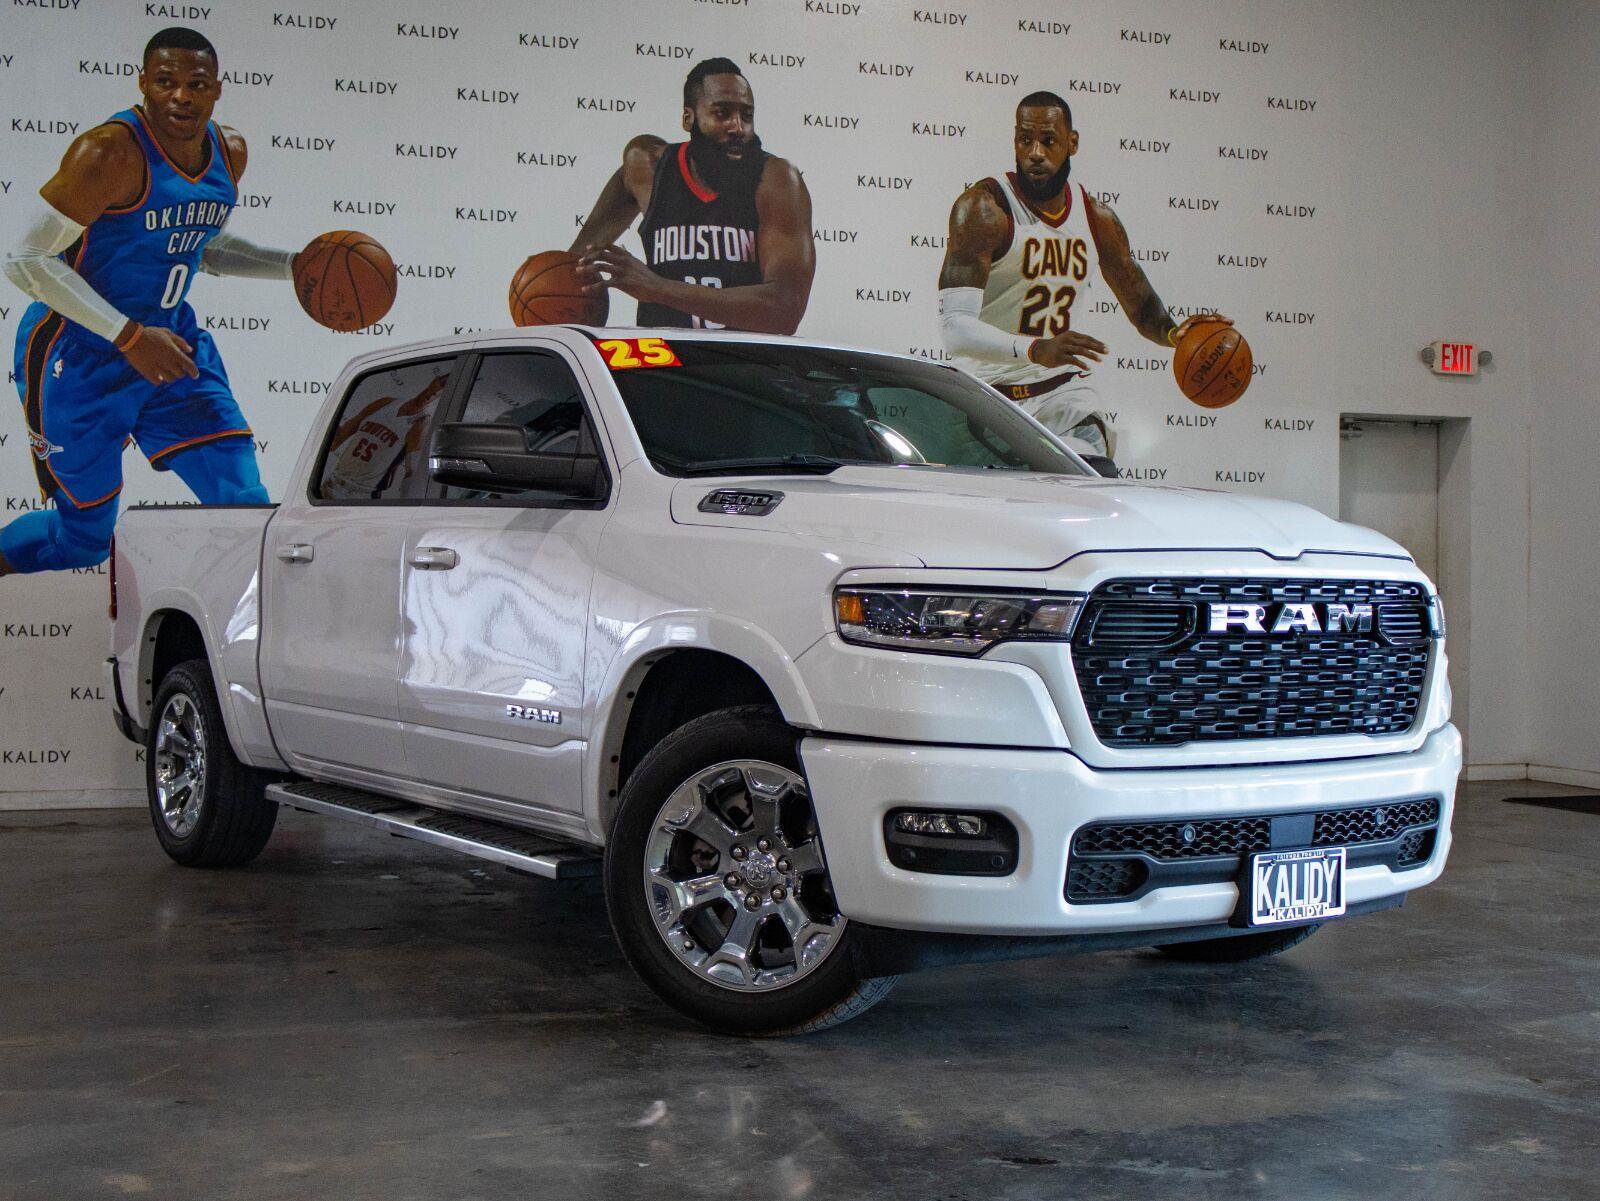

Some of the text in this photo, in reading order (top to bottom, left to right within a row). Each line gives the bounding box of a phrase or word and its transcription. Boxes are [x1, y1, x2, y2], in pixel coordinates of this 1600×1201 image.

[146, 3, 211, 20] KALIDY
[806, 0, 861, 16] KALIDY
[274, 13, 337, 30] KALIDY
[914, 11, 967, 26] KALIDY
[397, 23, 459, 39] KALIDY
[1019, 20, 1071, 35] KALIDY
[518, 33, 579, 49] KALIDY
[1121, 30, 1171, 45] KALIDY
[636, 43, 694, 59] KALIDY
[1219, 39, 1269, 54] KALIDY
[749, 52, 805, 68] KALIDY
[80, 60, 145, 77] KALIDY
[859, 61, 914, 77] KALIDY
[222, 71, 274, 87] ALIDY
[965, 71, 1019, 86] KALIDY
[335, 79, 398, 95] KALIDY
[1069, 80, 1121, 94] KALIDY
[457, 88, 519, 104] KALIDY
[1169, 89, 1220, 103] KALIDY
[577, 97, 636, 113] KALIDY
[1267, 97, 1316, 111] KALIDY
[12, 119, 79, 135] KALIDY
[804, 114, 859, 130] KALIDY
[912, 122, 966, 137] KALIDY
[272, 135, 335, 151] KALIDY
[1120, 139, 1171, 153] KALIDY
[396, 144, 457, 159] KALIDY
[1219, 147, 1268, 160] KALIDY
[517, 152, 577, 167] KALIDY
[858, 175, 912, 190] KALIDY
[235, 195, 272, 209] IDY
[1088, 191, 1120, 205] IDY
[1169, 197, 1219, 211] KALIDY
[334, 200, 396, 216] KALIDY
[456, 207, 517, 222] KALIDY
[1267, 204, 1316, 218] KALIDY
[144, 201, 230, 231] OKLAHOM
[166, 230, 207, 254] CITY
[812, 229, 858, 244] ALIDY
[911, 235, 950, 249] KALI
[653, 224, 757, 265] HOUSTON
[1021, 236, 1089, 282] CAVS
[1129, 249, 1169, 264] ALIDY
[1218, 254, 1267, 268] KALIDY
[394, 263, 457, 280] KALIDY
[160, 263, 190, 310] 0
[856, 288, 911, 303] KALIDY
[1018, 284, 1077, 338] 23
[1089, 301, 1119, 314] IDY
[205, 316, 270, 331] KALIDY
[1266, 311, 1315, 325] KALIDY
[600, 338, 675, 367] 25
[1441, 343, 1473, 374] EXIT
[1118, 358, 1168, 371] KALIDY
[268, 380, 332, 394] KALIDY
[1012, 385, 1031, 400] CLE
[1167, 414, 1217, 427] KALIDY
[1265, 418, 1314, 431] KALIDY
[1117, 467, 1167, 480] KALIDY
[1216, 471, 1265, 483] KALIDY
[7, 497, 56, 510] KALI
[1208, 602, 1373, 634] RAM
[5, 624, 72, 637] KALIDY
[71, 686, 105, 701] KAL
[506, 704, 562, 725] RAM
[3, 750, 71, 763] KALIDY
[1257, 860, 1339, 911] KALIDY
[1277, 903, 1323, 920] KALIDY
